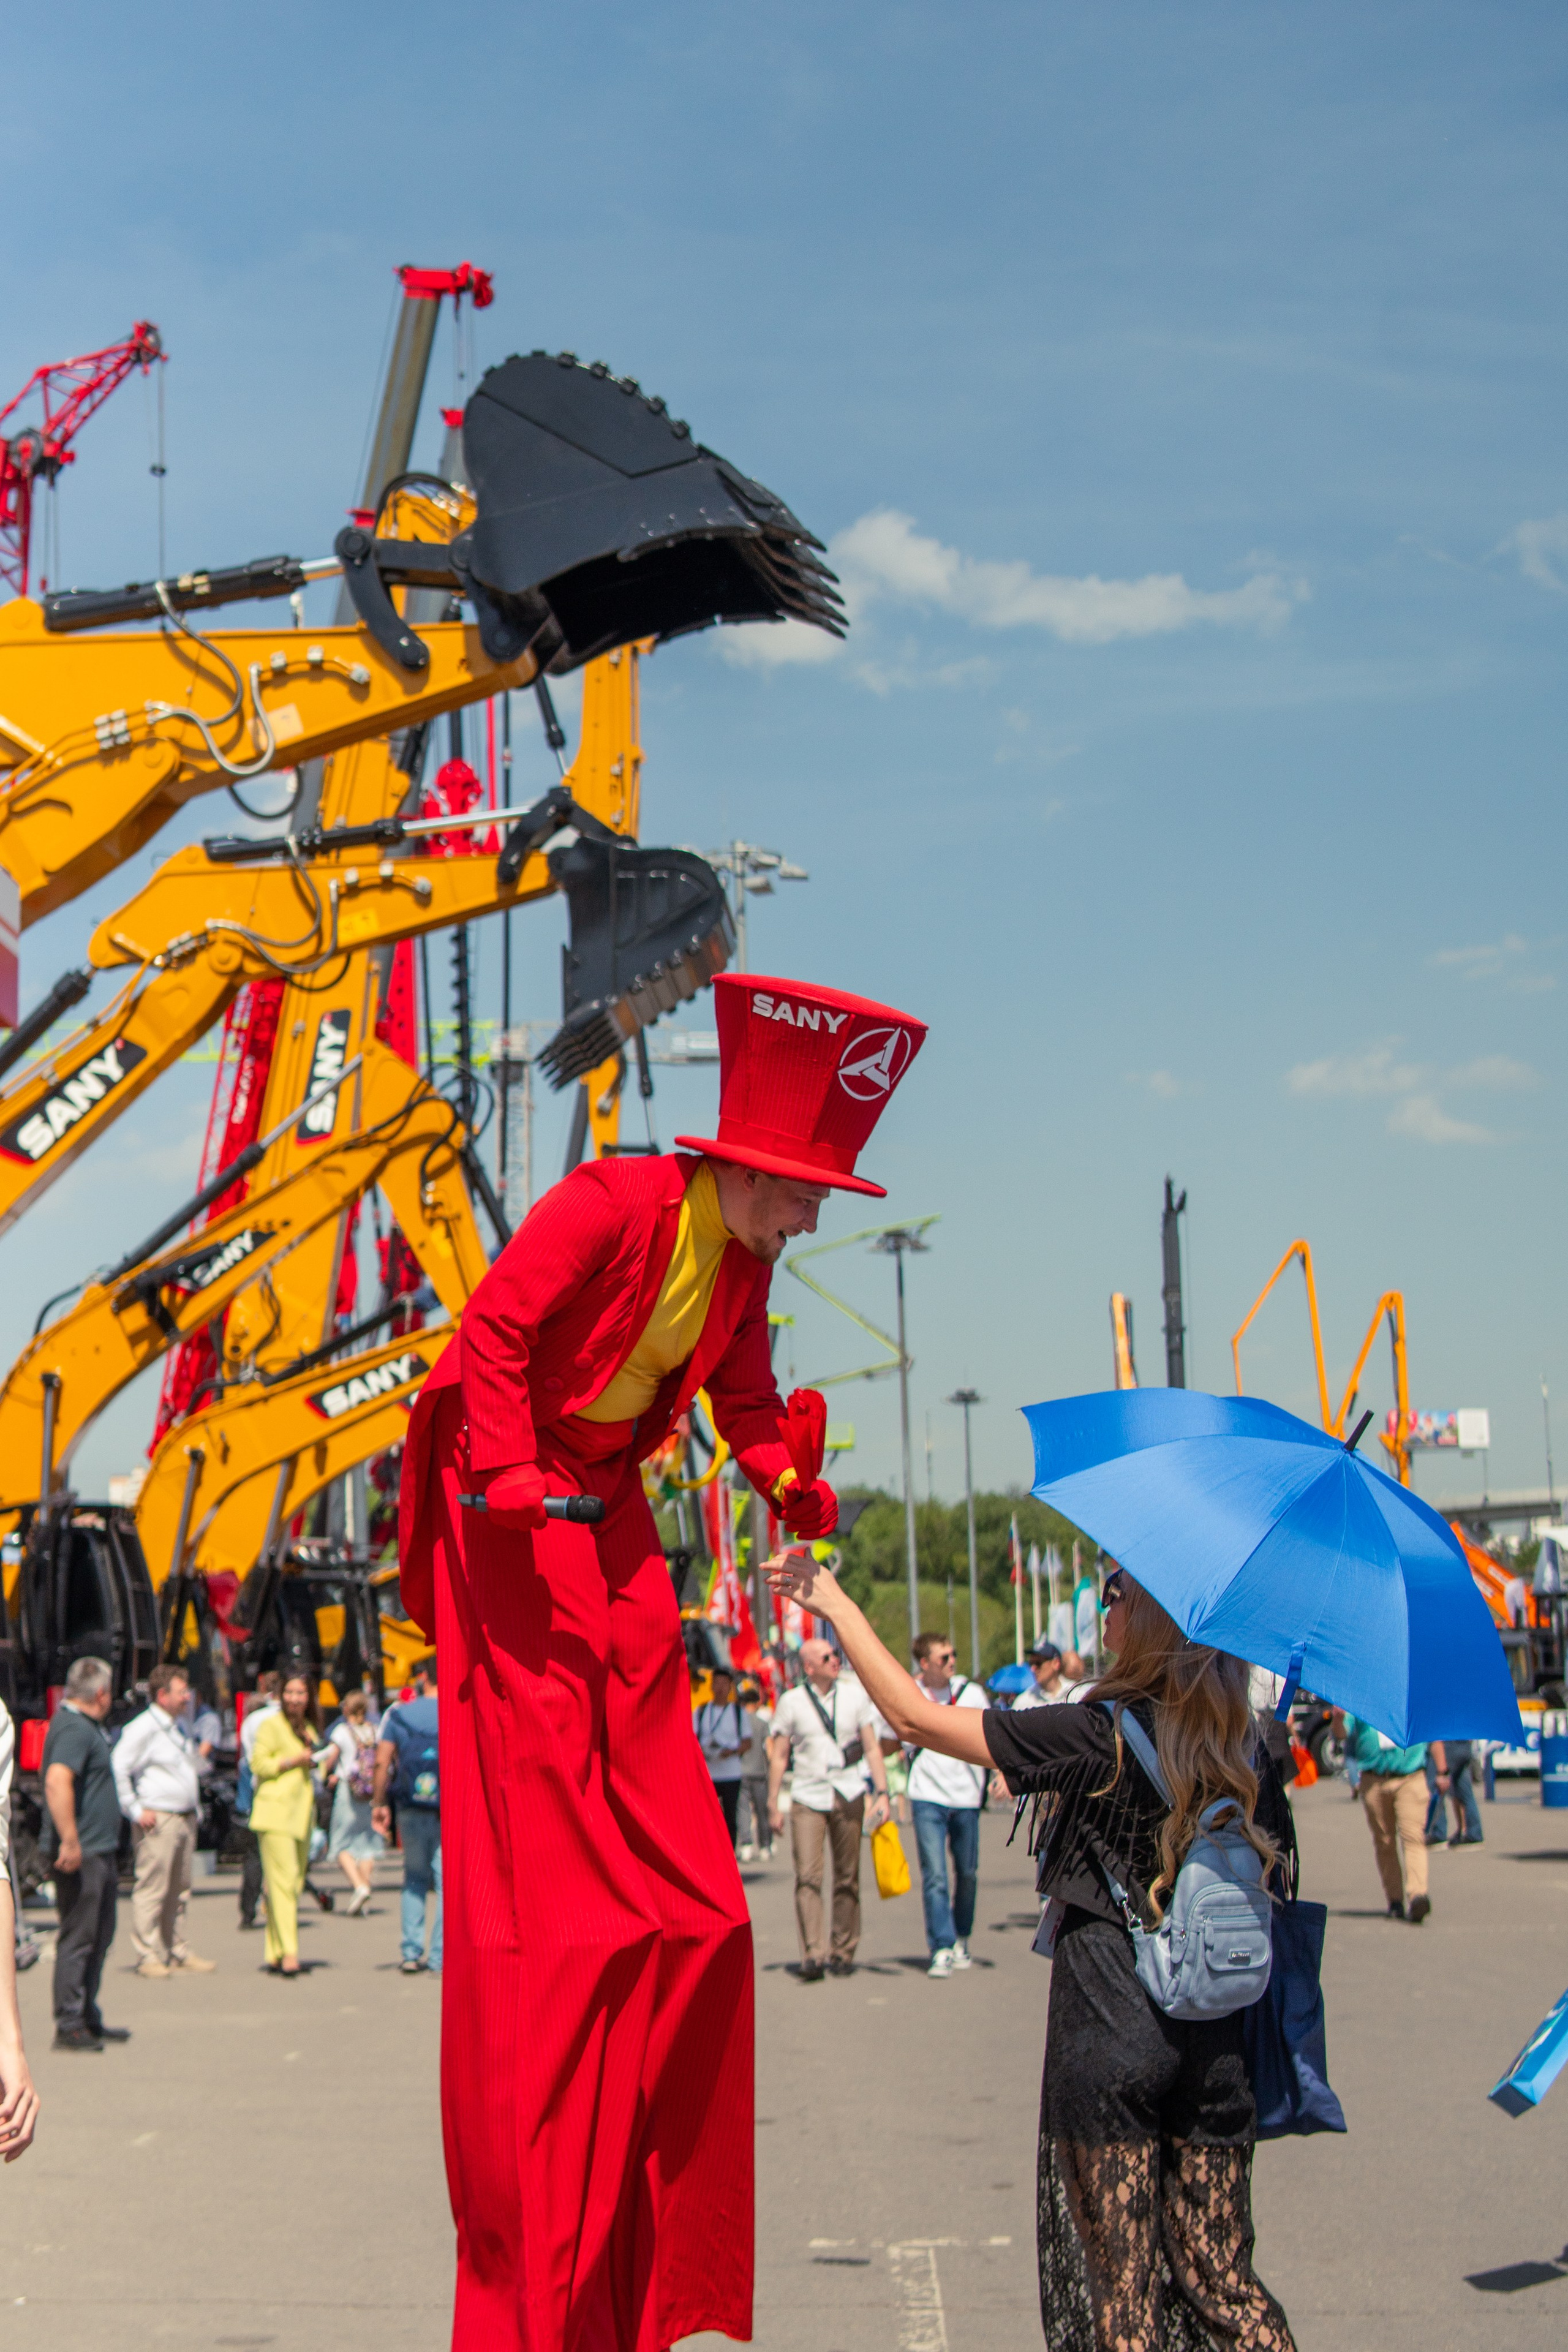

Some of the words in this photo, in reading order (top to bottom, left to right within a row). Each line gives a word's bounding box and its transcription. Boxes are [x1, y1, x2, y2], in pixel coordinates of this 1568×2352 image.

[752, 993, 848, 1034] SANY
[17, 1044, 124, 1160] SANY
[322, 1352, 411, 1418] SANY
